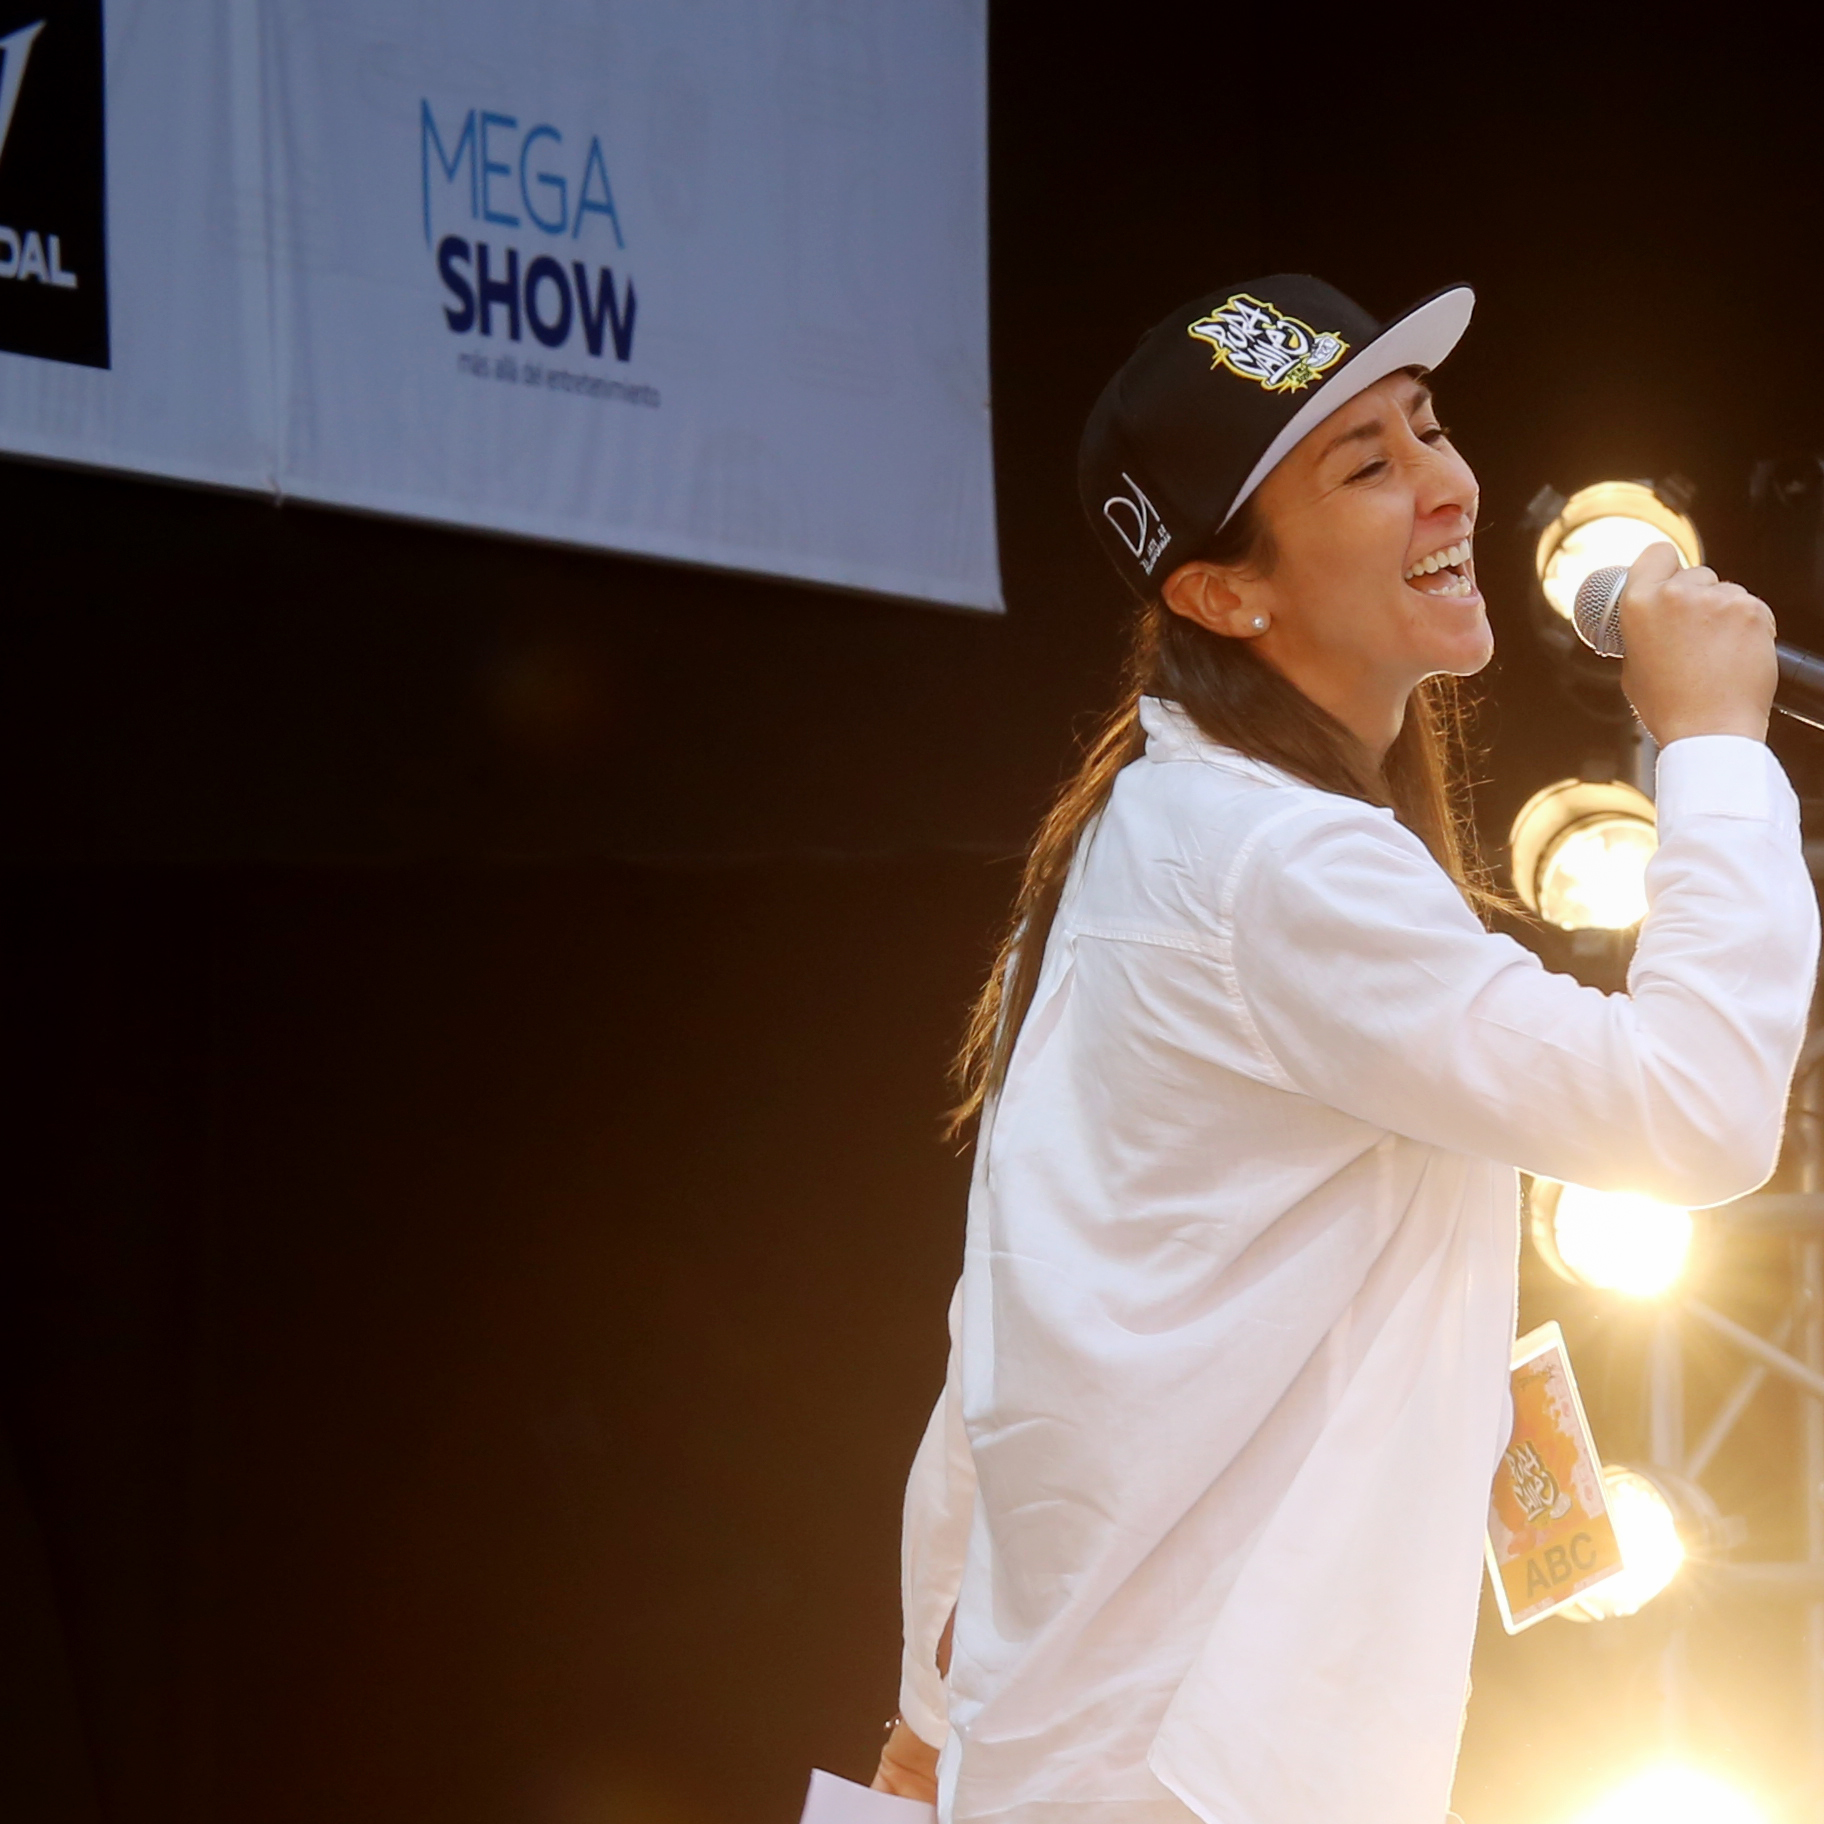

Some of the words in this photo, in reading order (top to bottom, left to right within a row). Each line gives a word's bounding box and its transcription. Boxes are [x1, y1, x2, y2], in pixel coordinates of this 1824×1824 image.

[420, 97, 625, 250] MEGA
[437, 233, 637, 363] SHOW
[1526, 1531, 1597, 1599] ABC
